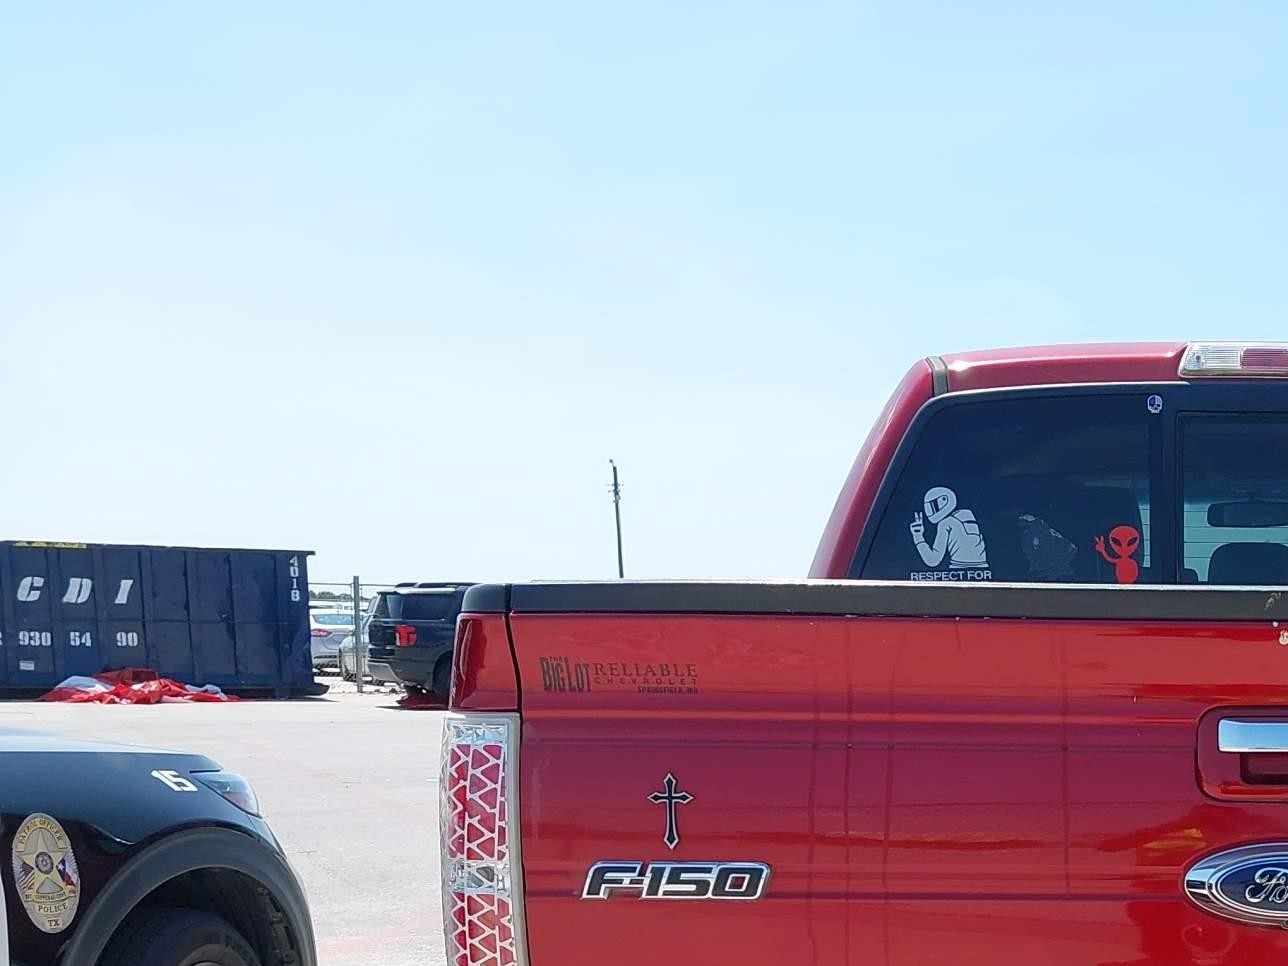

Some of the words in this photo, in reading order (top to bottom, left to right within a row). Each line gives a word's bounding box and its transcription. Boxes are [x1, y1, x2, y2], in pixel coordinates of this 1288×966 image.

[290, 555, 300, 602] 4018
[910, 571, 963, 581] RESPECT
[967, 571, 992, 580] FOR
[17, 576, 134, 604] CDI
[19, 631, 52, 646] 930
[70, 632, 92, 647] 54
[116, 632, 138, 647] 90
[540, 656, 566, 692] BIG
[564, 656, 591, 692] LOT
[593, 662, 698, 677] RELIABLE
[594, 678, 697, 686] CHEVROLET
[151, 769, 198, 792] 15
[18, 820, 38, 845] PATROL
[580, 861, 771, 900] F-150
[38, 902, 67, 913] POLICE
[47, 919, 60, 928] TX
